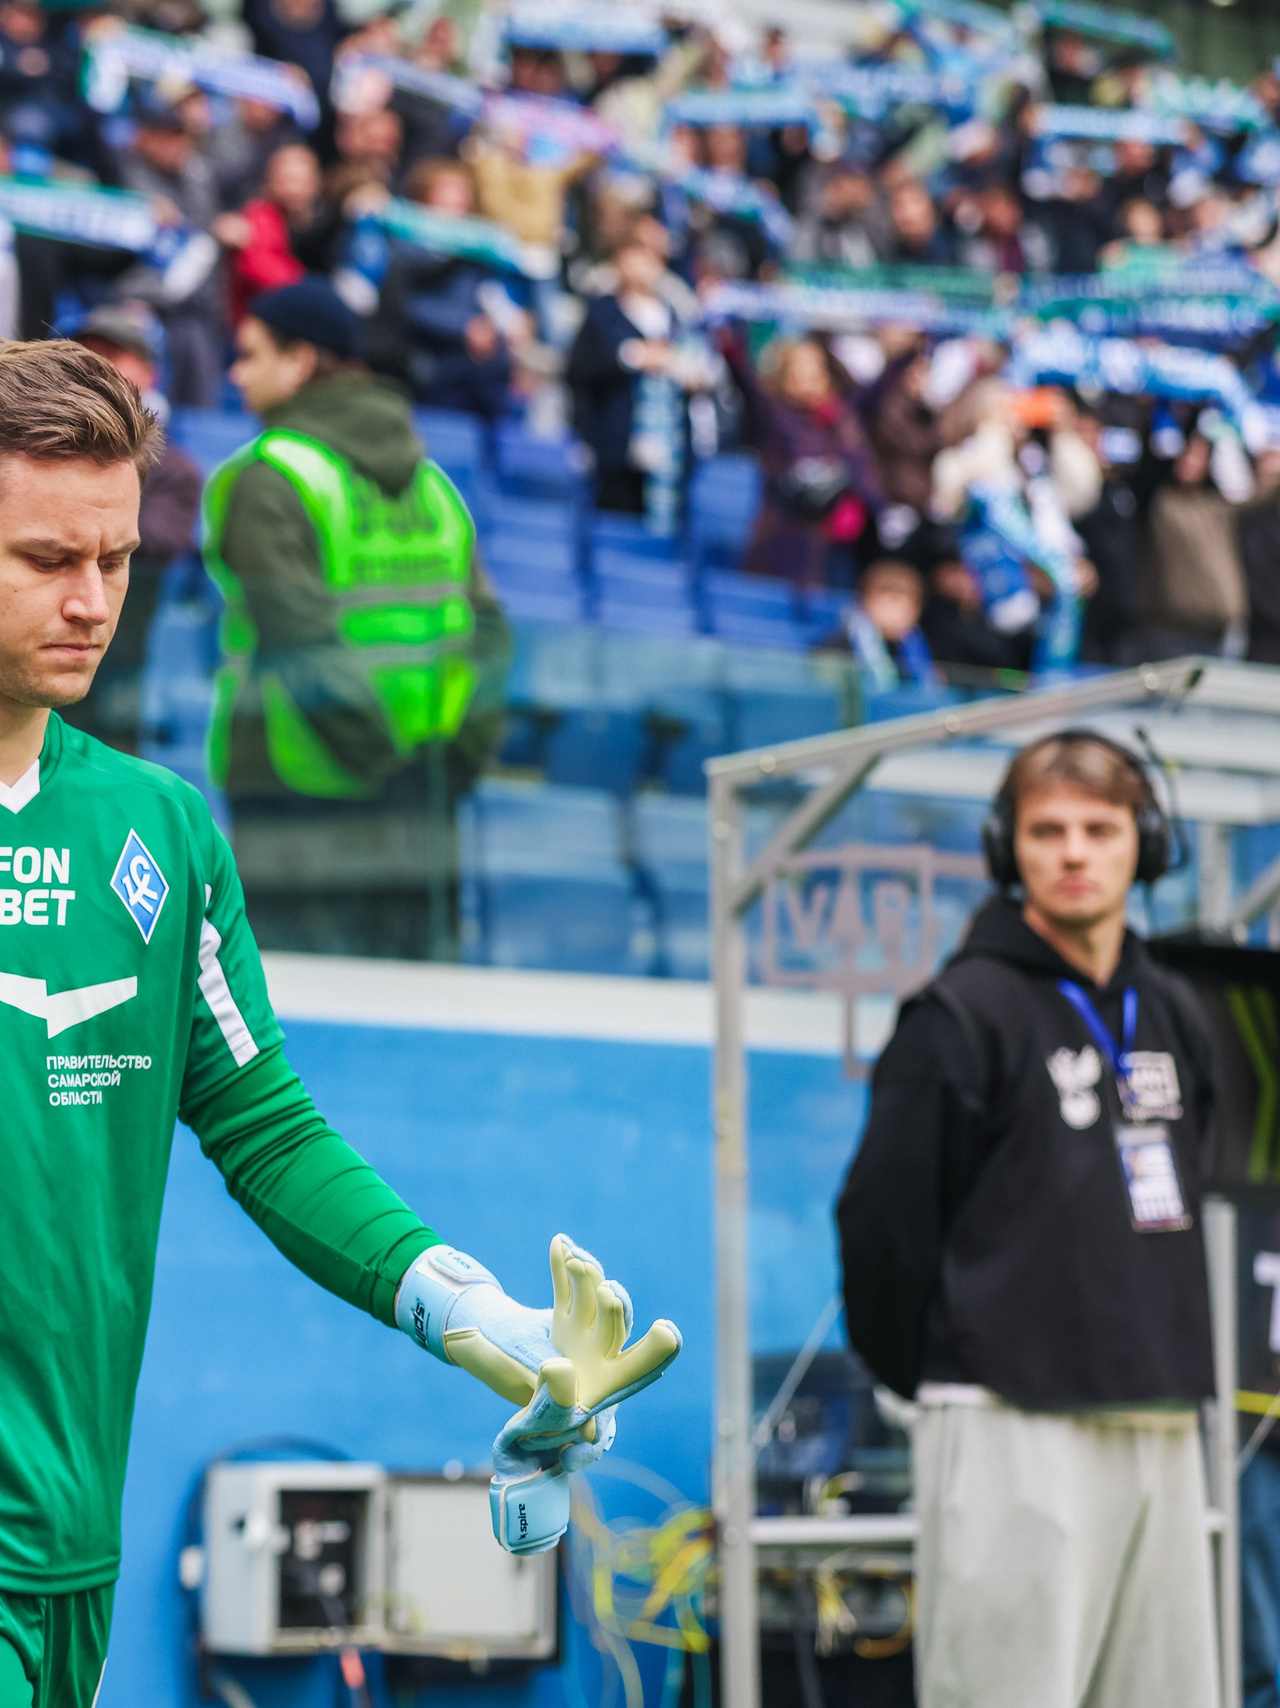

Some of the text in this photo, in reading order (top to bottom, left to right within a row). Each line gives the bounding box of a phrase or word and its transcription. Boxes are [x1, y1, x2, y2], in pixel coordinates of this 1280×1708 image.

[46, 1055, 152, 1070] ПРАВИТЕЛЬСТВО
[47, 1070, 121, 1088] САМАРСКОЙ
[48, 1090, 102, 1106] ОБЛАСТИ
